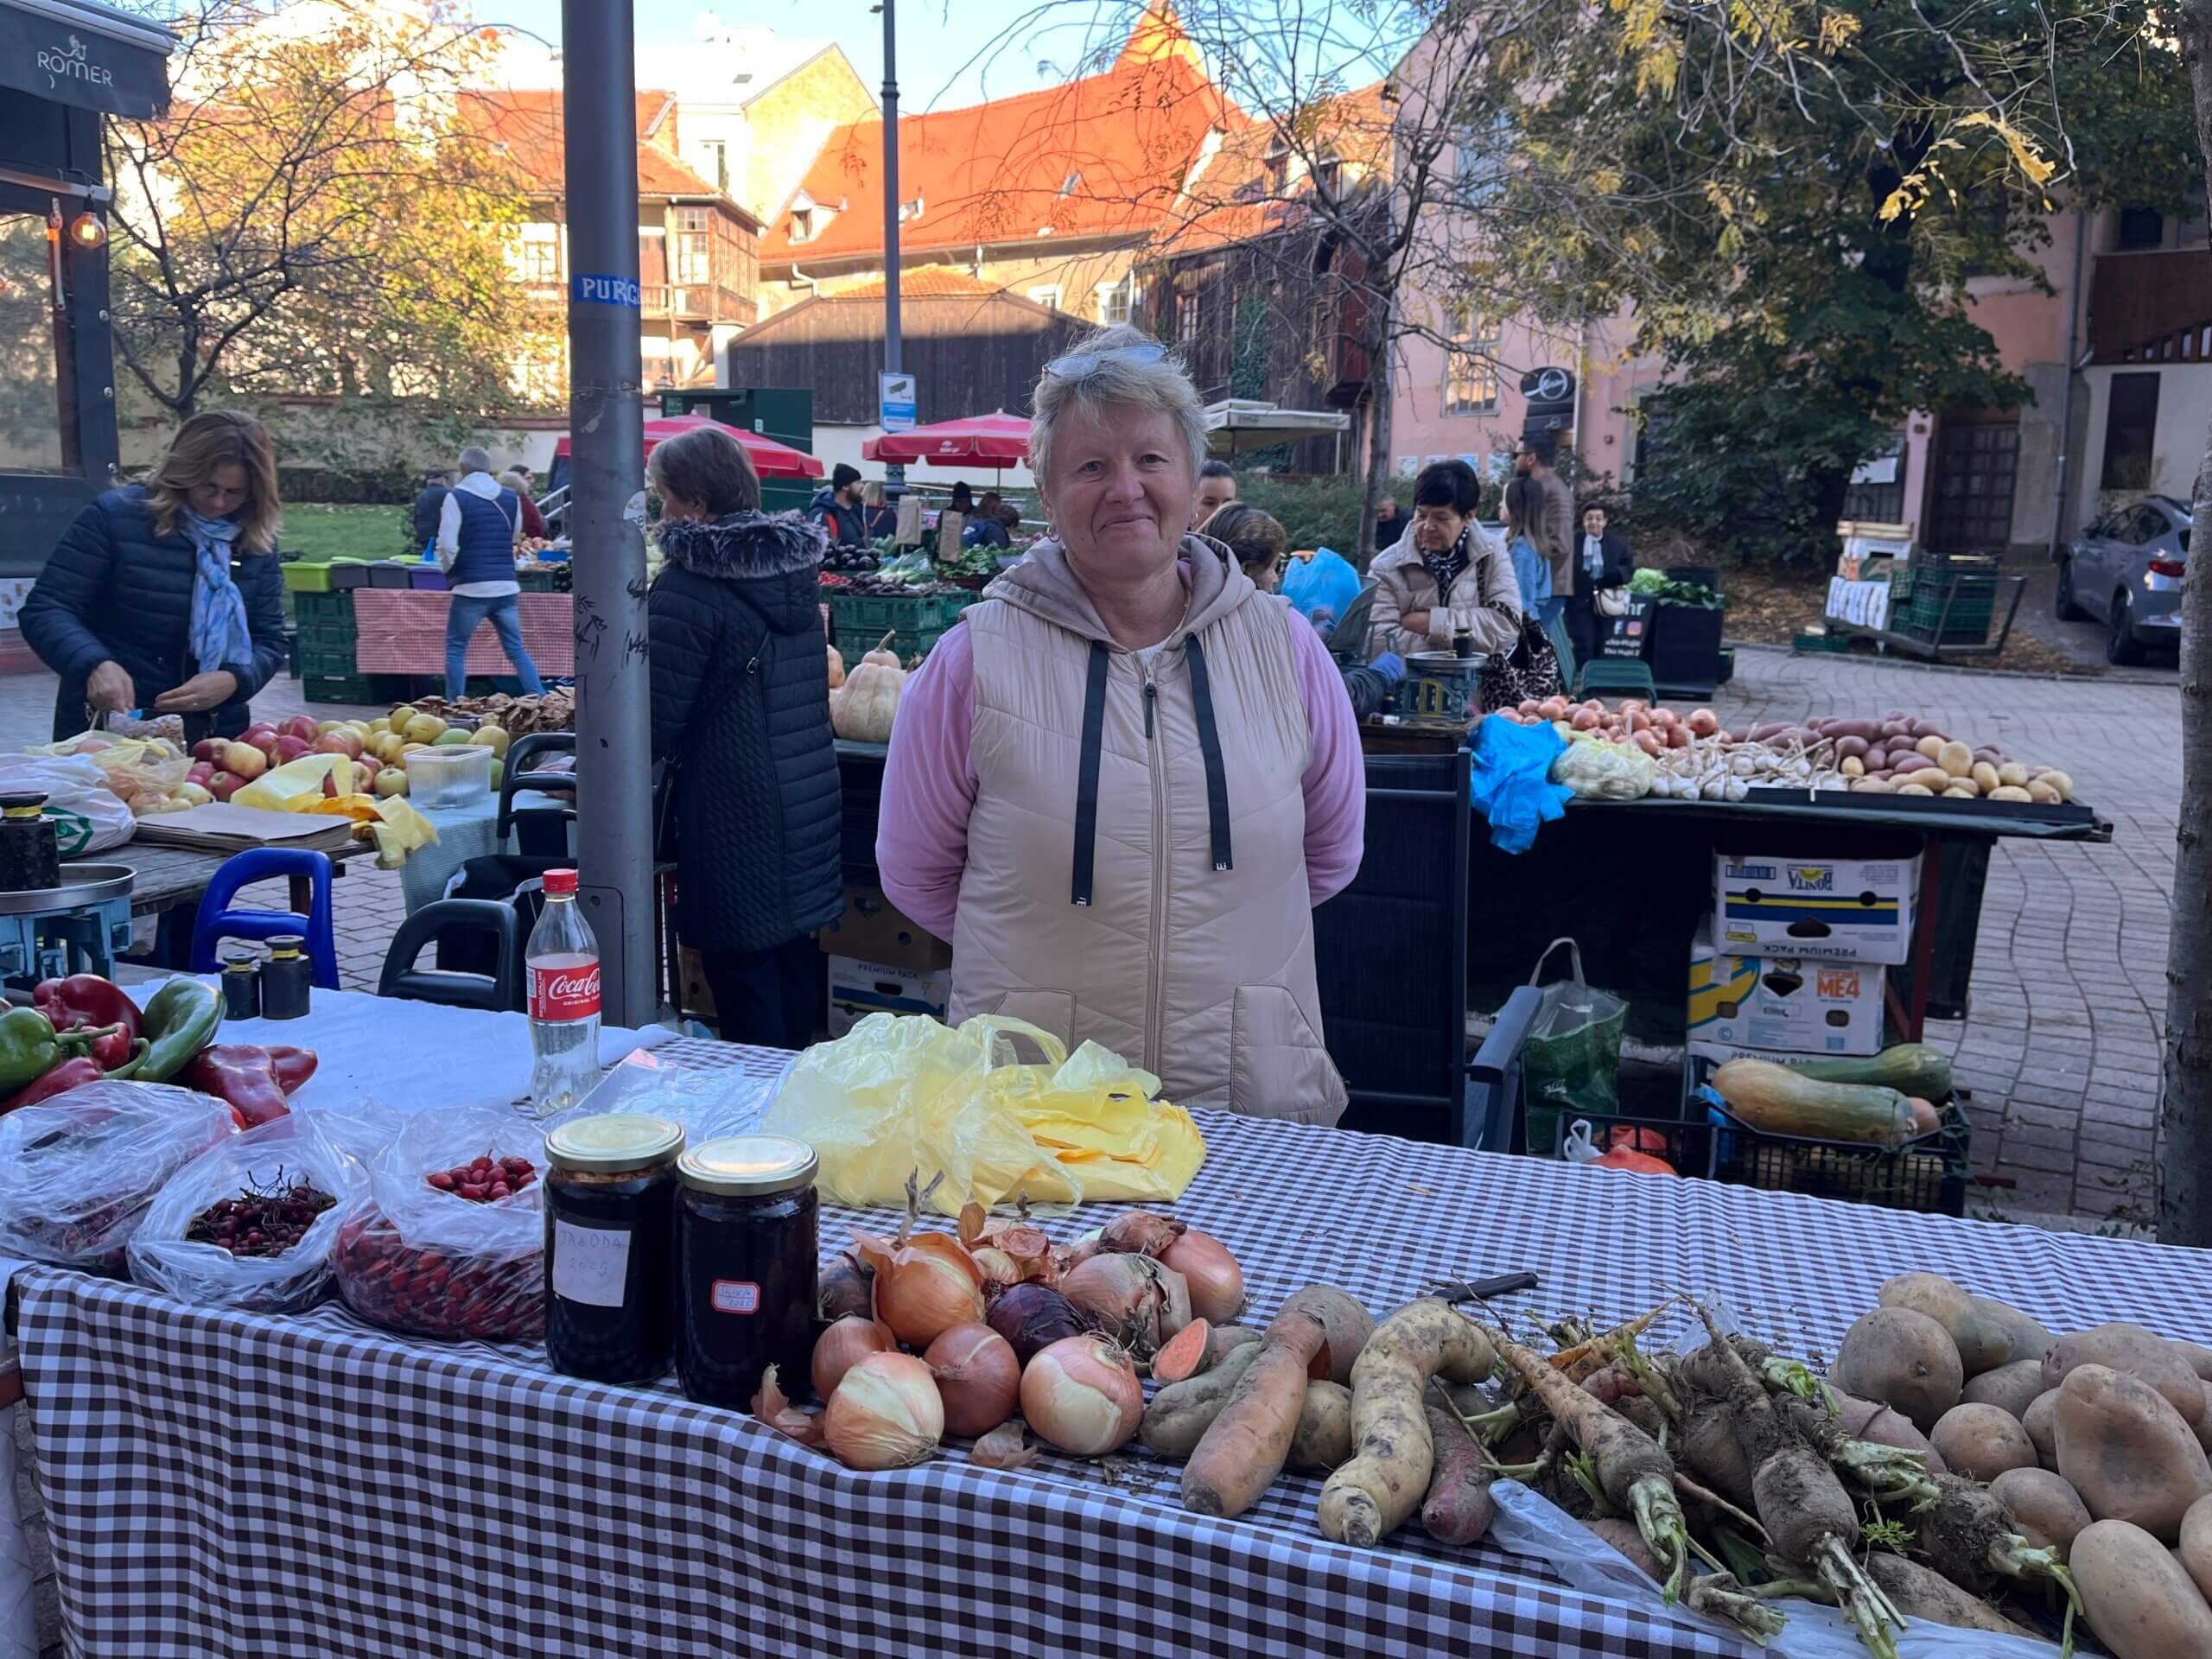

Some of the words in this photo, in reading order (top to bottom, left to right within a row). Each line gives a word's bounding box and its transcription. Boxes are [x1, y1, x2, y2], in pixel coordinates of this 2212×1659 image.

[1787, 871, 1834, 891] BONITA
[1764, 944, 1793, 954] PACK
[1796, 946, 1857, 957] PREMIUM
[549, 968, 601, 1000] Coca-Co
